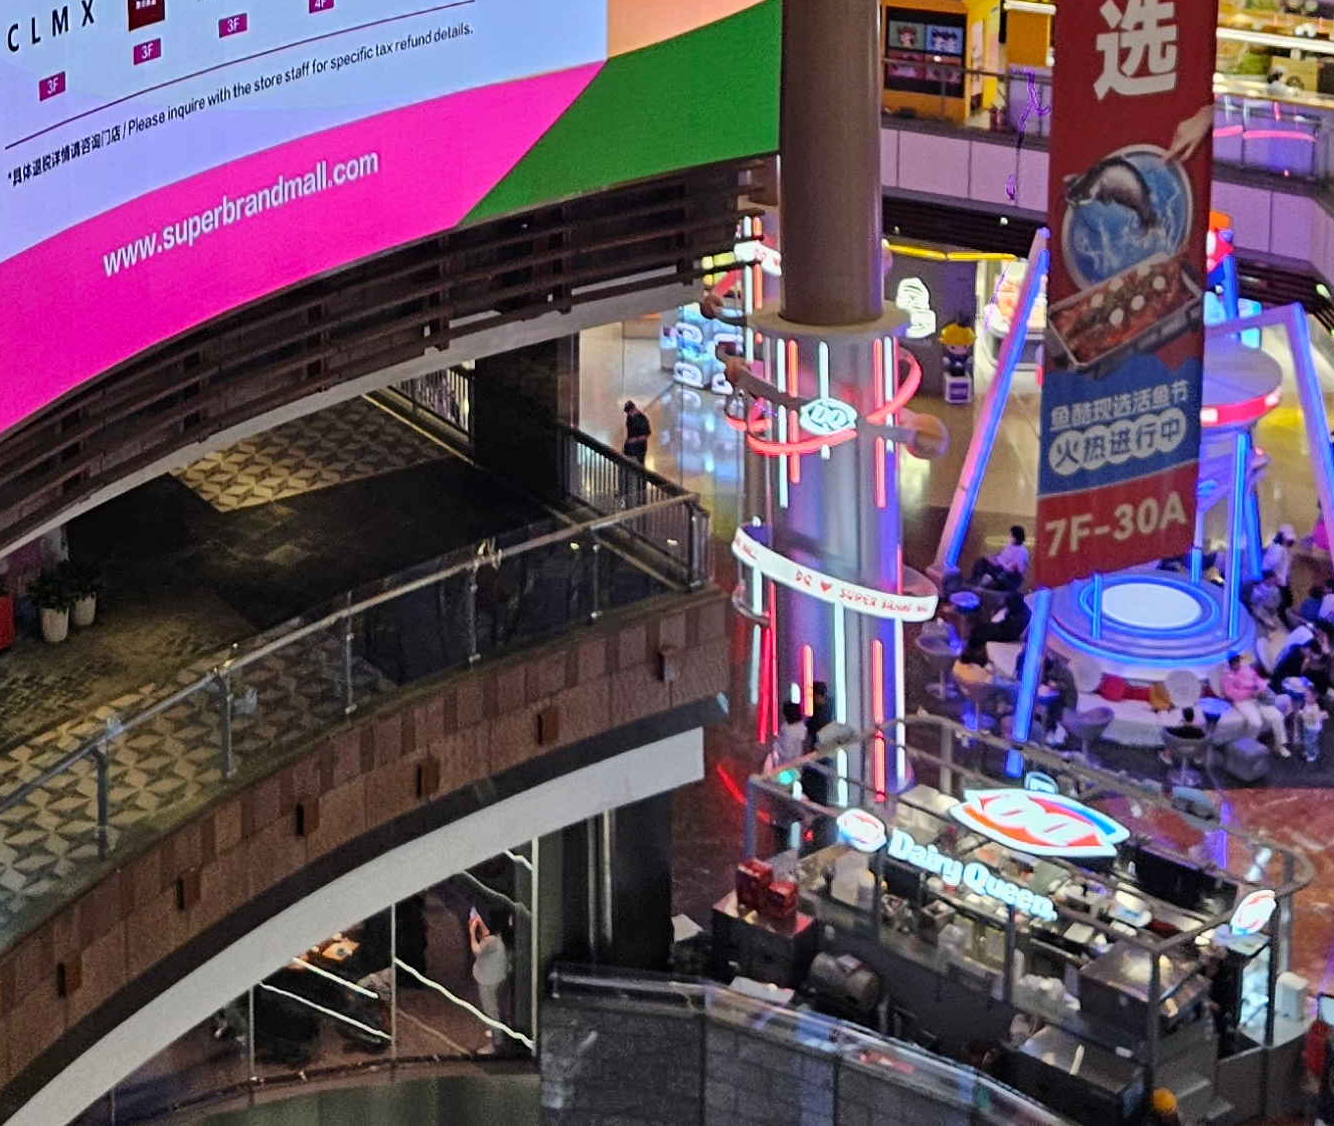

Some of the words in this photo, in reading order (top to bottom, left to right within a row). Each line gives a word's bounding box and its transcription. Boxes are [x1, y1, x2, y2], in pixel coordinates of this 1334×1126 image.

[227, 17, 241, 32] 3F
[141, 44, 154, 59] 3F
[47, 77, 59, 94] 3F
[128, 110, 166, 136] Please
[167, 97, 206, 121] inquire
[208, 86, 231, 105] with
[233, 81, 252, 99] the
[254, 74, 283, 93] store
[285, 61, 310, 82] staff
[312, 58, 328, 74] for
[330, 46, 374, 71] specific
[375, 42, 394, 57] tax
[395, 30, 432, 52] refund
[434, 22, 474, 43] details.
[103, 151, 379, 277] www.superbrandmall.com
[1056, 418, 1180, 468] 火热进行中
[1045, 491, 1187, 558] 7F-30A
[795, 570, 812, 587] DQ
[839, 588, 877, 607] SUPER
[888, 827, 964, 888] Dairy
[964, 862, 1056, 921] Queen
